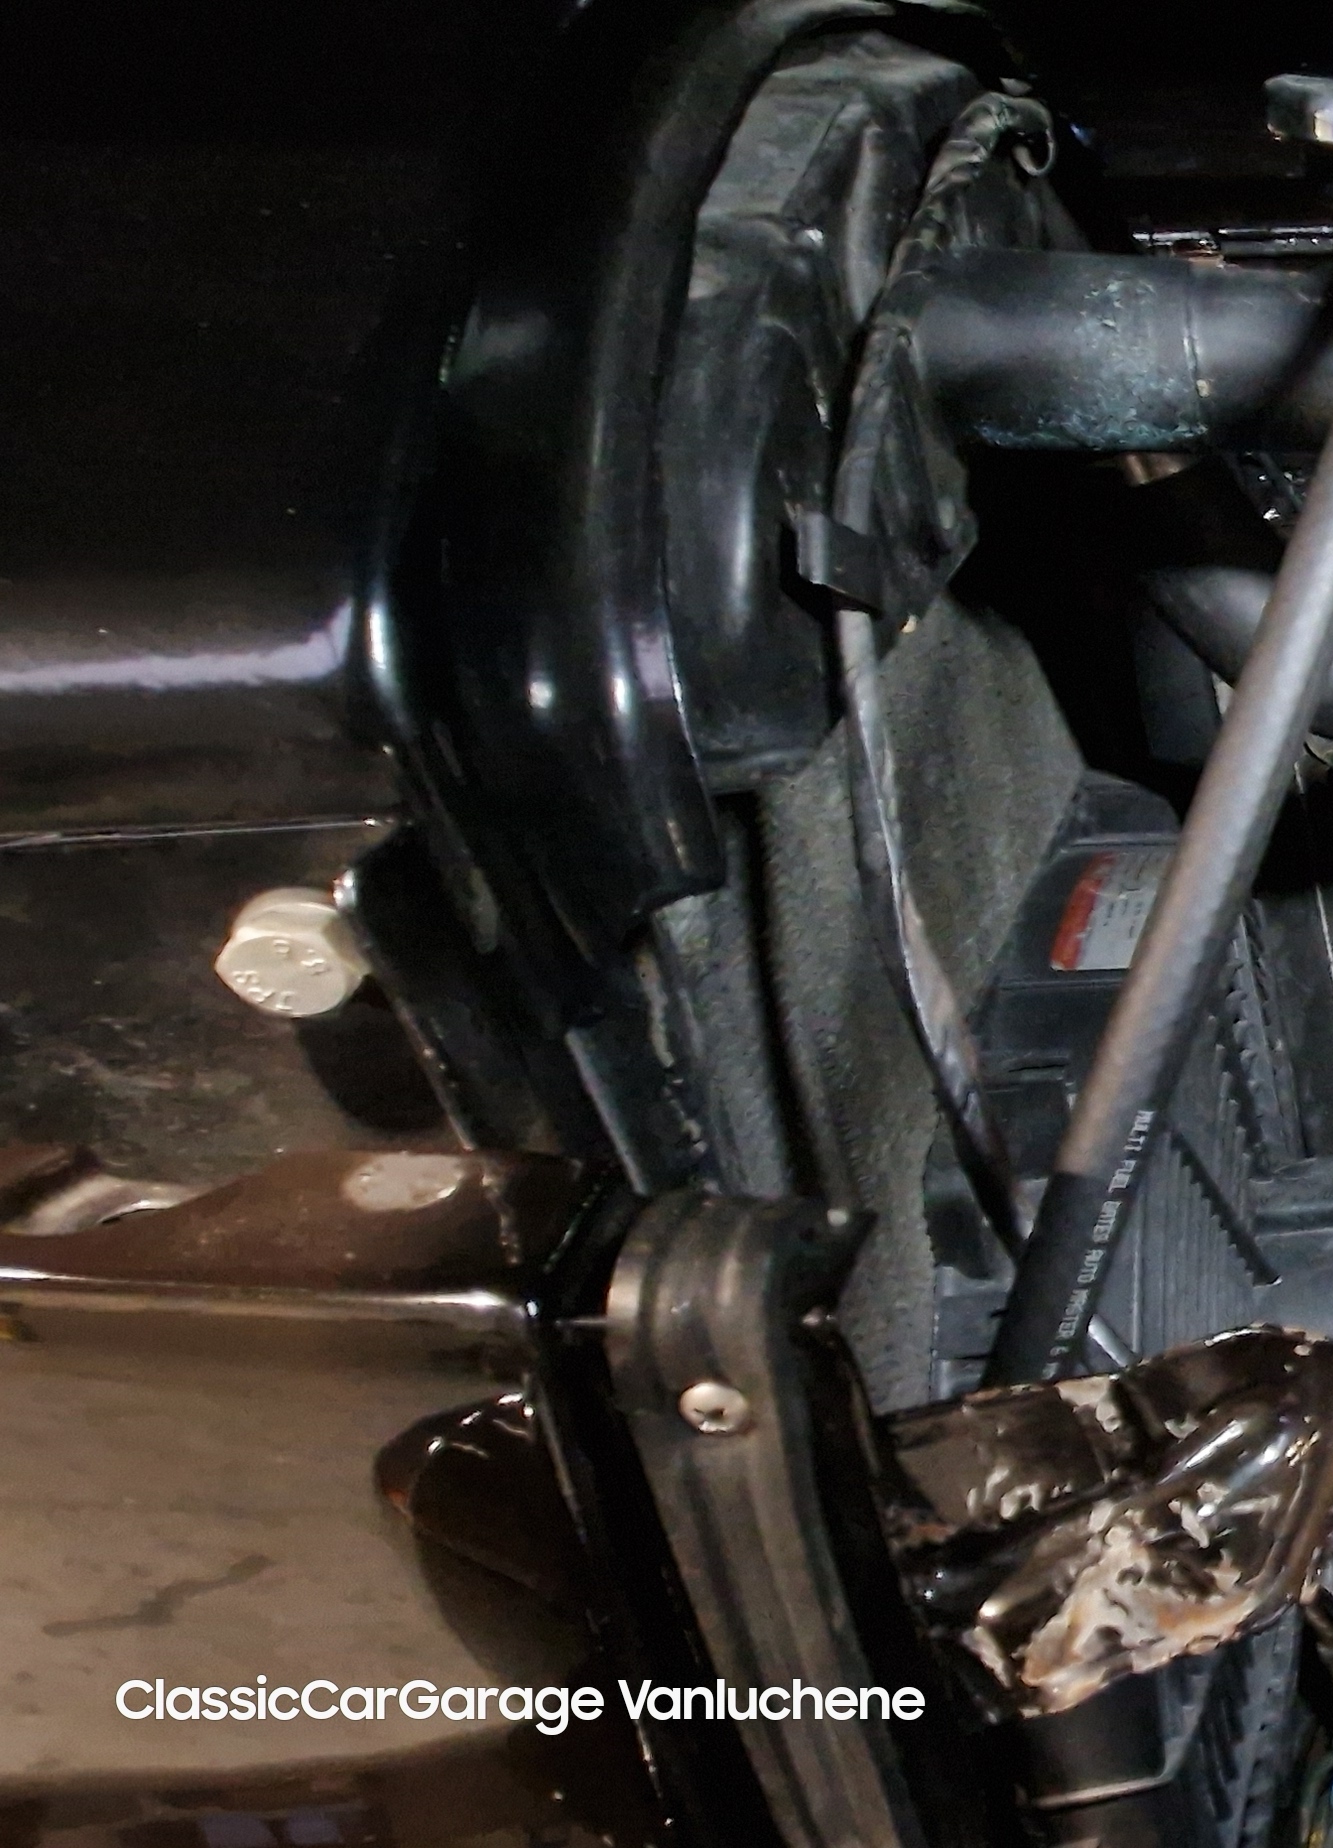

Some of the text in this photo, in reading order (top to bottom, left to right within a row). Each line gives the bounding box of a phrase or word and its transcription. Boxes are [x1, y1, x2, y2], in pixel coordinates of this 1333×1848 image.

[1124, 1110, 1155, 1152] MULTI
[1108, 1159, 1137, 1193] FUEL
[1077, 1248, 1104, 1283] AUTO
